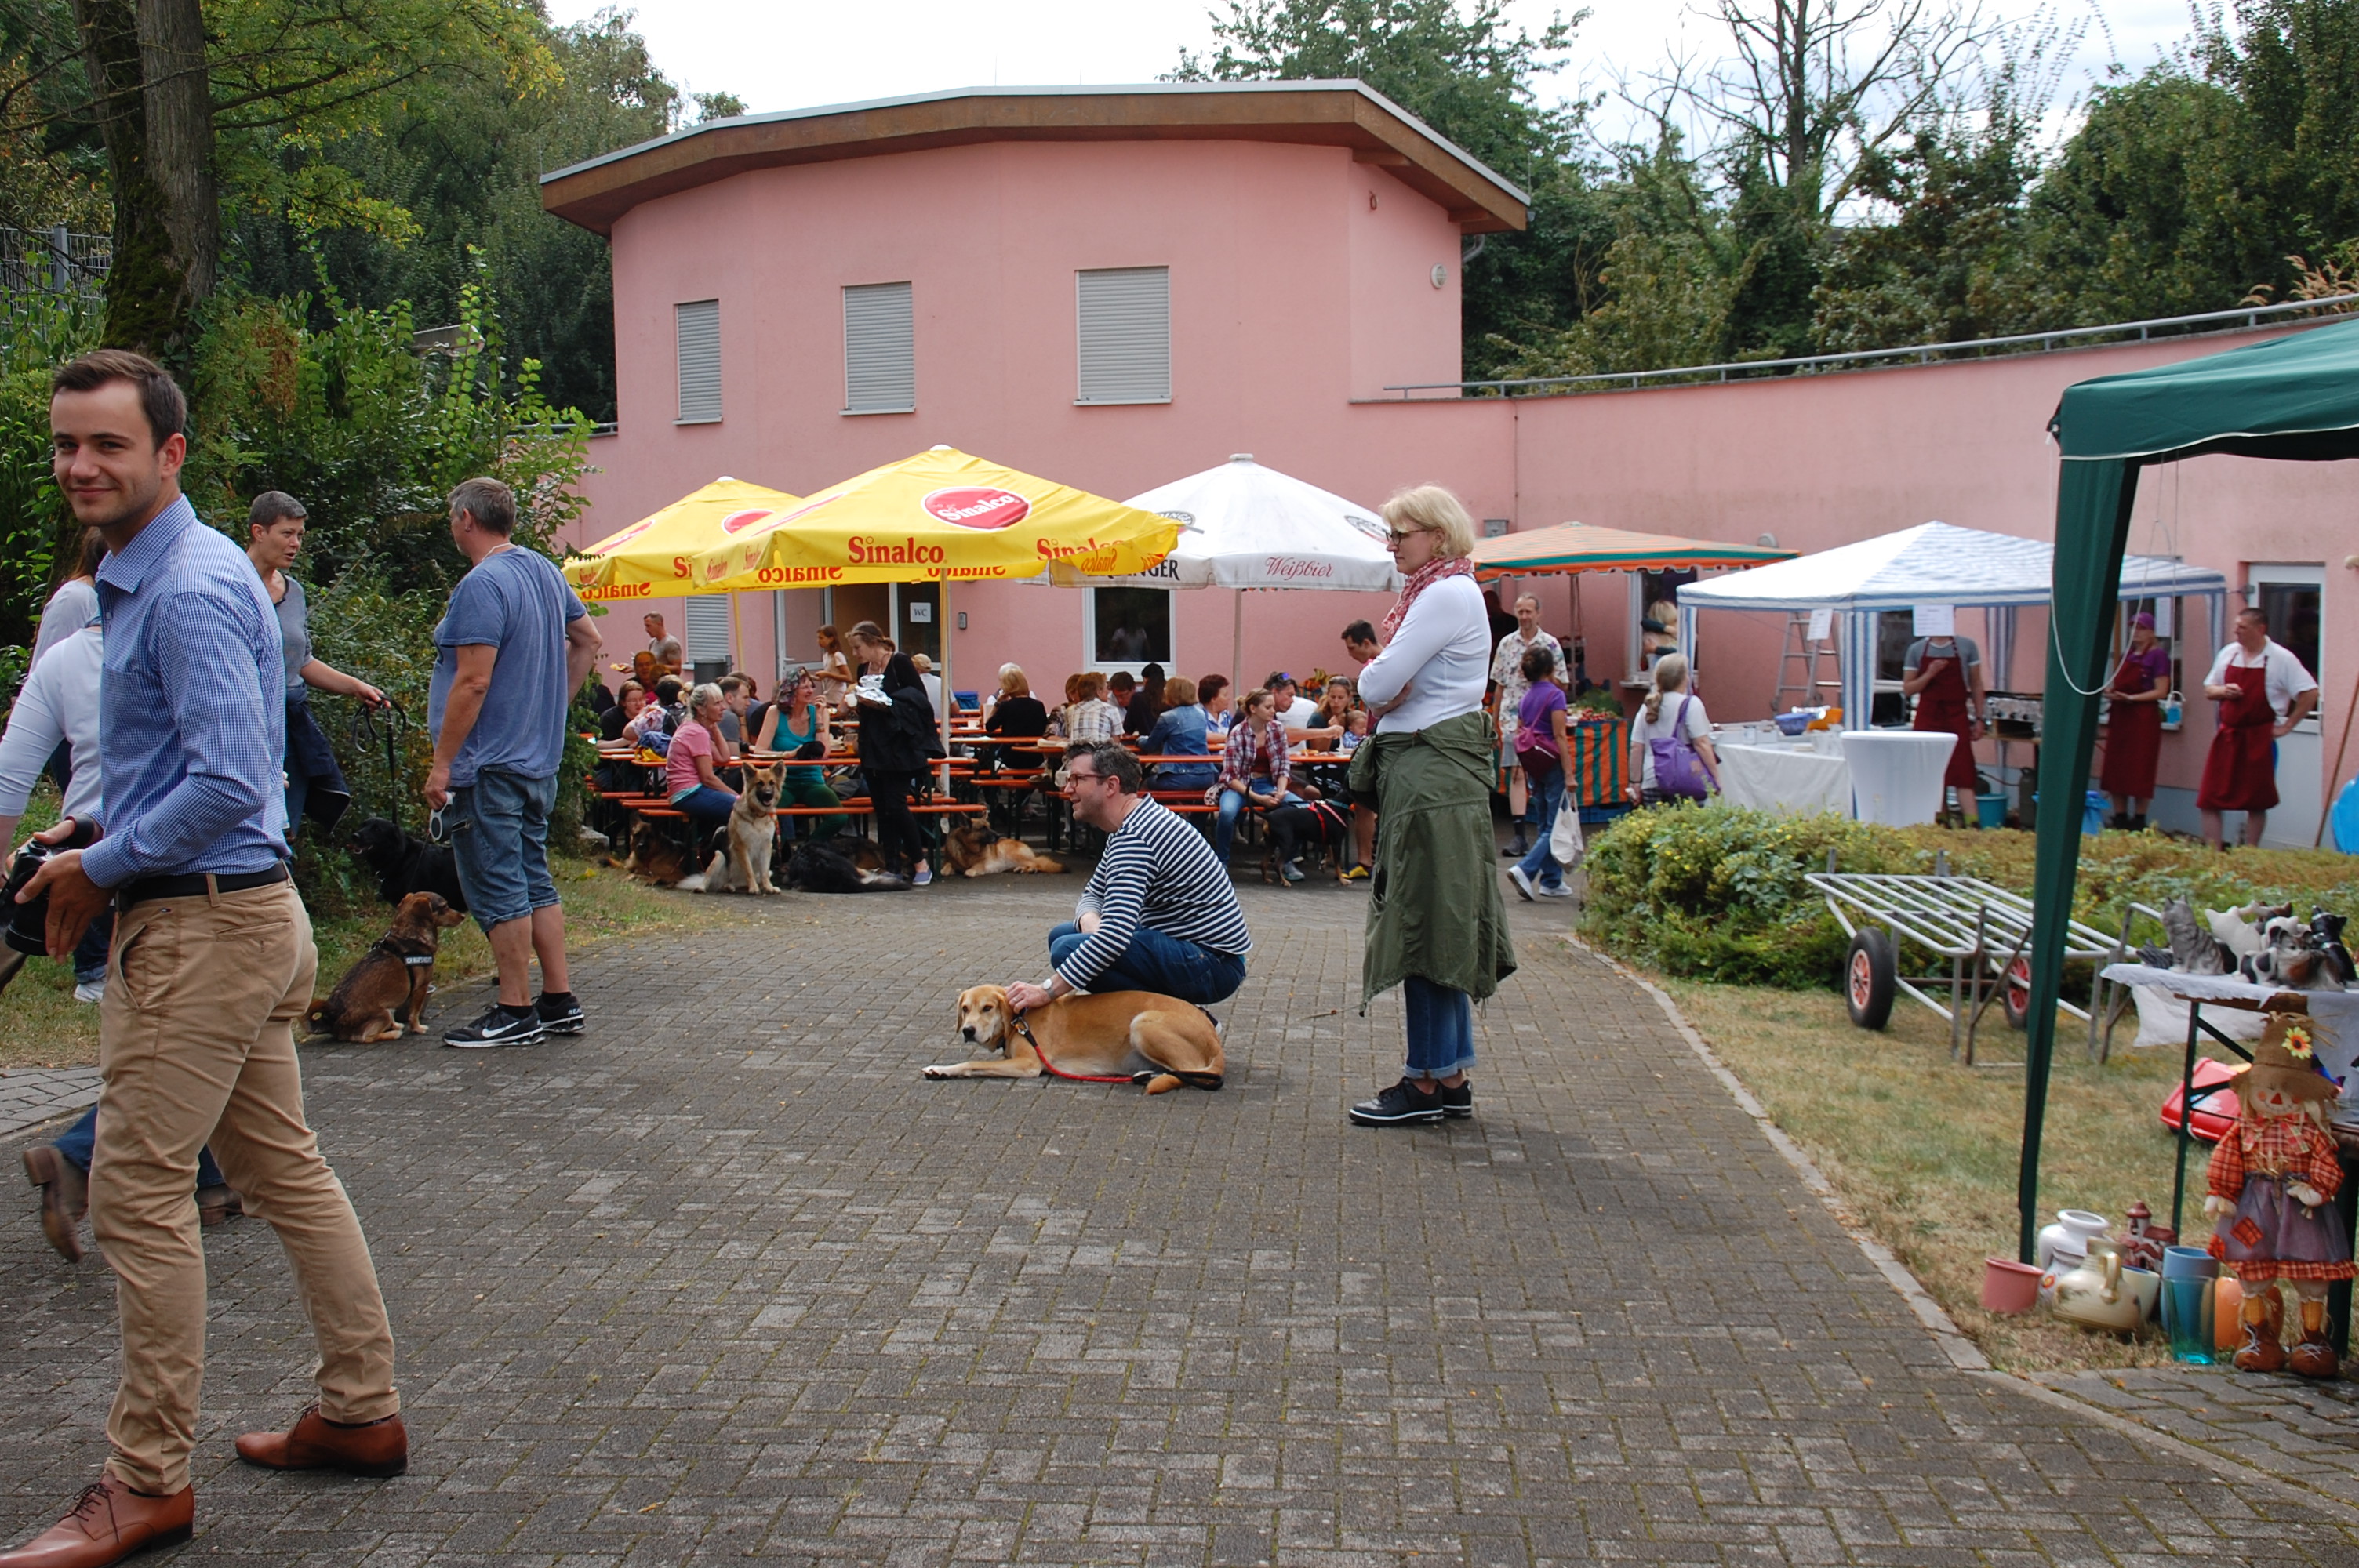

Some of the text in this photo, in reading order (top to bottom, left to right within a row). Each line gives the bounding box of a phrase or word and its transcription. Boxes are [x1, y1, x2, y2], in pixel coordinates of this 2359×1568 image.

[936, 495, 1015, 521] Sinalco
[848, 535, 944, 564] Sinalco
[1265, 556, 1334, 581] Weißbier
[914, 608, 928, 617] WC
